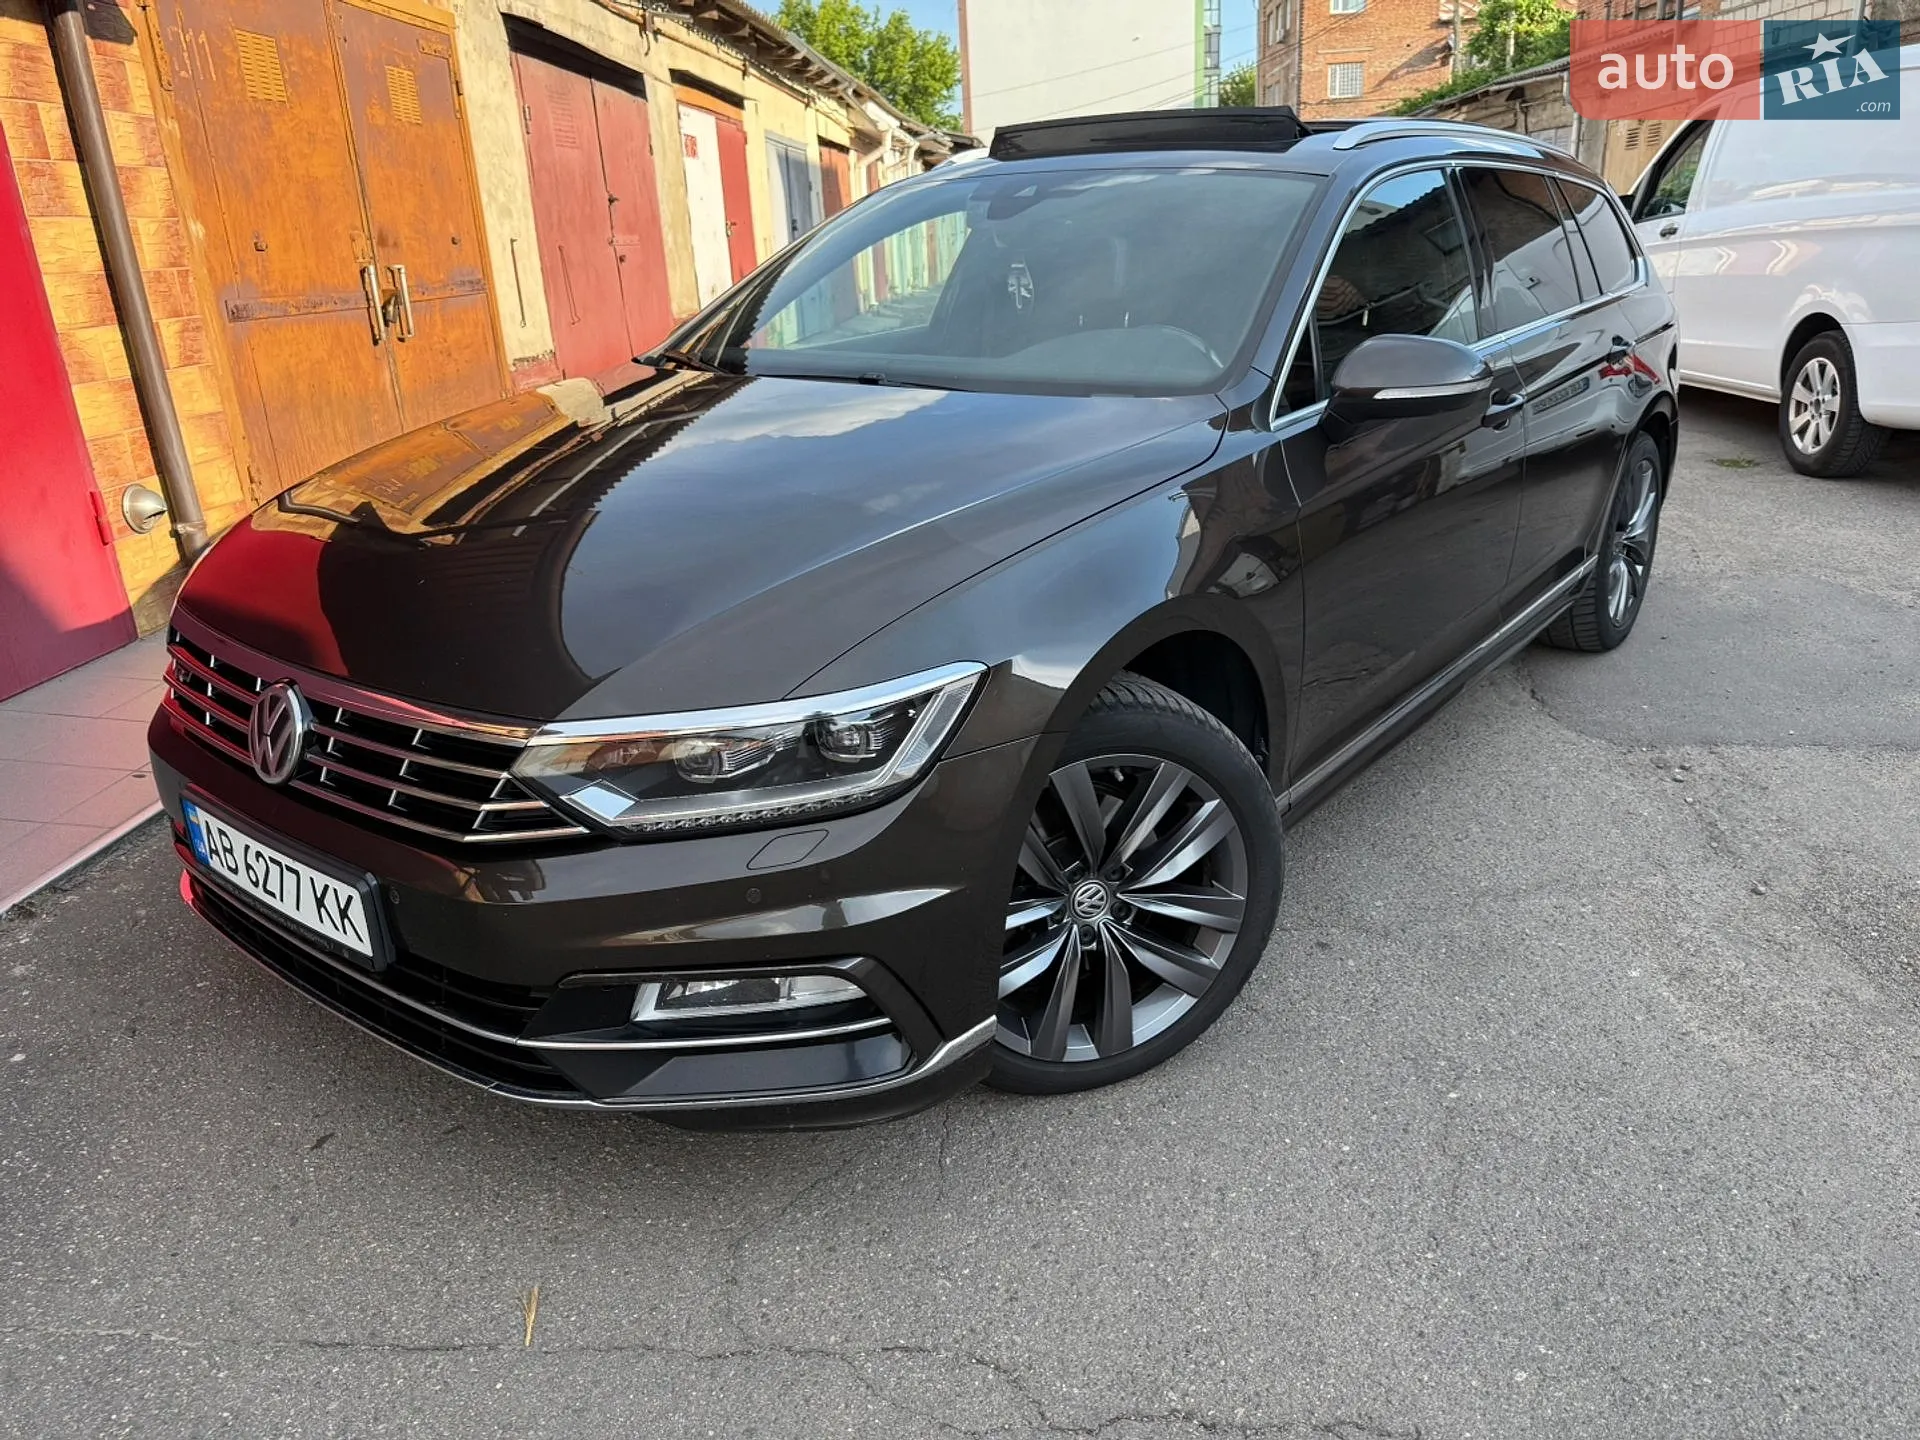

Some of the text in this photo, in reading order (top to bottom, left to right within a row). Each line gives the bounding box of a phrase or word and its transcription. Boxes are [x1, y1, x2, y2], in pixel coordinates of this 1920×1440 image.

[204, 819, 239, 875] AB
[243, 843, 302, 912] 6277
[309, 876, 364, 944] KK
